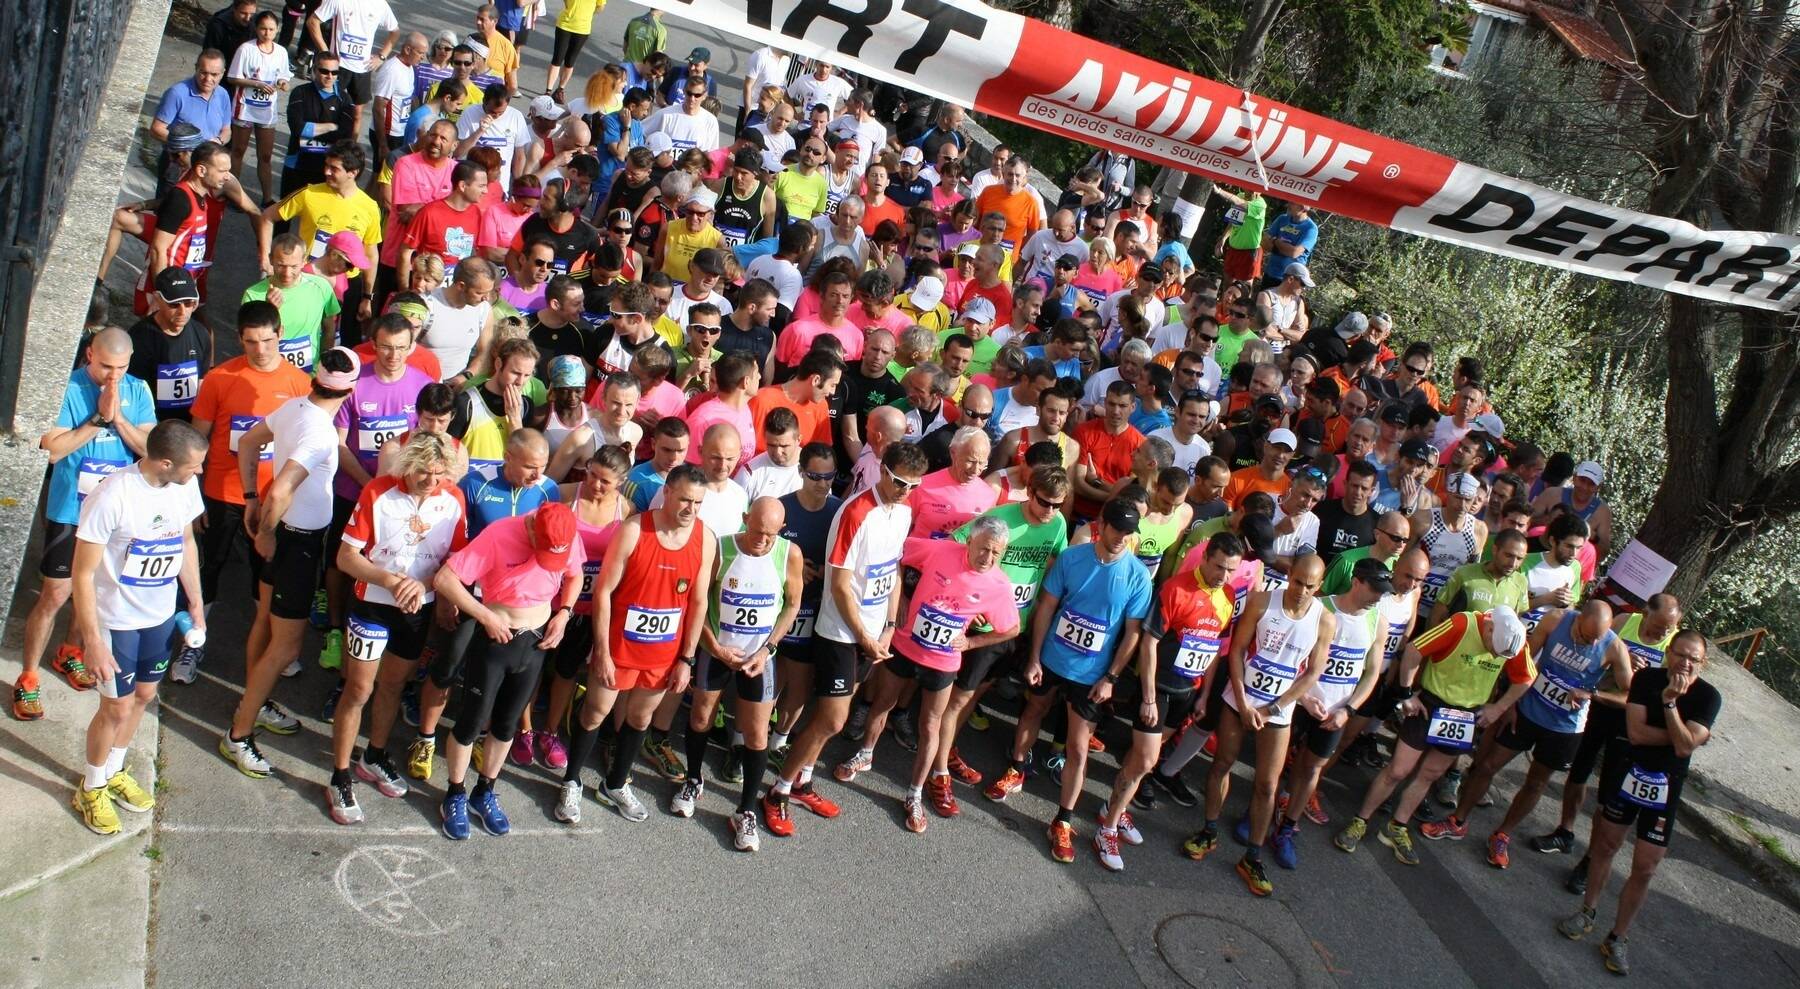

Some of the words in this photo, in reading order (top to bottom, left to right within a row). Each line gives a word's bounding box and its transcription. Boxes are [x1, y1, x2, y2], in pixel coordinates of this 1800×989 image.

[347, 43, 363, 56] 103
[1026, 101, 1058, 119] des
[1061, 111, 1108, 134] pieds
[1113, 127, 1155, 148] sains
[1170, 144, 1230, 171] souples
[280, 351, 304, 366] 88
[174, 379, 190, 398] 51
[139, 556, 174, 577] 107
[1002, 550, 1048, 563] FINISHER
[873, 577, 892, 597] 334
[636, 613, 670, 634] 290
[735, 607, 758, 626] 26
[920, 621, 952, 645] 313
[1064, 623, 1095, 648] 218
[1185, 652, 1210, 670] 310
[1324, 658, 1354, 677] 265
[1252, 671, 1283, 695] 321
[1541, 681, 1569, 705] 144
[1437, 721, 1466, 740] 285
[1631, 780, 1660, 801] 158
